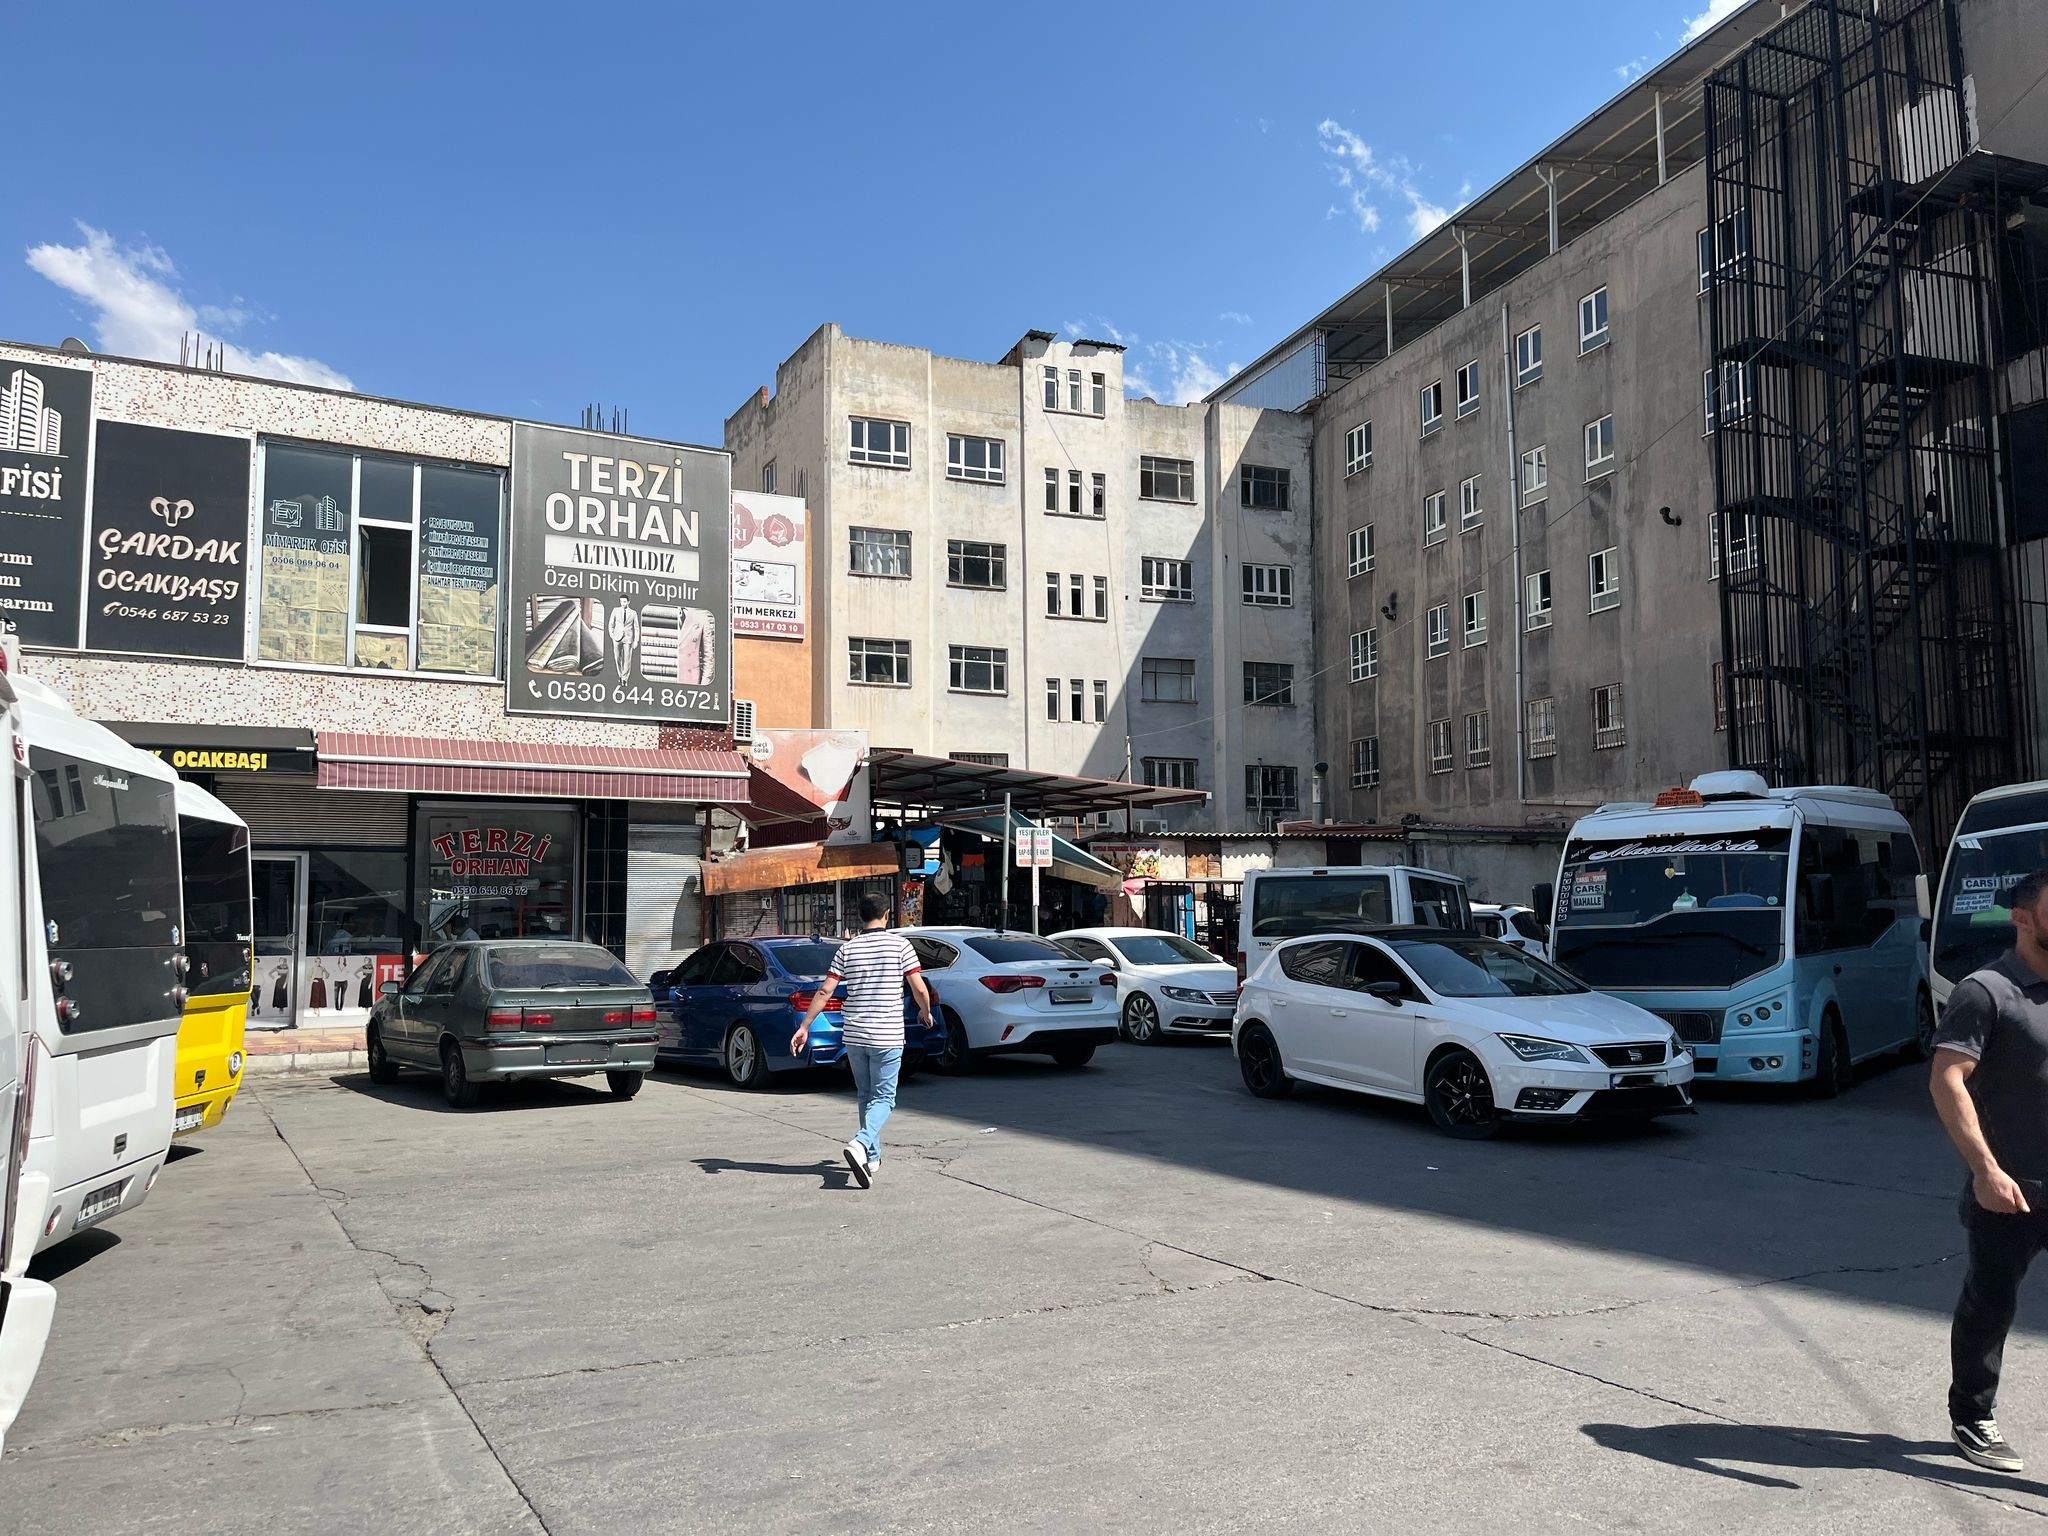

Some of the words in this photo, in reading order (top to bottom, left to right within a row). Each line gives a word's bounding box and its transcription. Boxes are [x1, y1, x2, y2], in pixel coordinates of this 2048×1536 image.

[562, 451, 684, 505] TERZİ
[545, 492, 700, 548] ORHAN
[98, 527, 242, 564] ÇARDAK
[265, 532, 317, 550] MİMARLIK
[320, 538, 348, 555] OFİSİ
[272, 556, 294, 565] 0506
[328, 561, 340, 569] 04
[571, 542, 675, 574] ALTINYILDIZ
[97, 568, 239, 604] OCAKBAŞI
[544, 565, 583, 589] Özel
[589, 572, 639, 594] Dikim
[645, 578, 699, 602] Yapılır
[119, 605, 157, 619] 0546
[162, 610, 188, 622] 687
[192, 612, 209, 624] 53
[212, 614, 229, 625] 23
[755, 607, 796, 619] MERKEZİ
[740, 620, 759, 630] 0533
[762, 622, 775, 631] 147
[777, 623, 787, 632] 03
[789, 624, 798, 632] 10
[547, 680, 605, 702] 0530
[612, 684, 654, 706] 644
[660, 688, 711, 710] 8672
[173, 750, 268, 771] OCAKBAŞI
[432, 827, 552, 863] TERZİ
[451, 857, 530, 876] ORHAN
[452, 885, 477, 896] 0530
[479, 885, 498, 896] 644
[500, 885, 513, 896] 86
[515, 885, 528, 896] 72
[1573, 896, 1602, 907] MAHALLE
